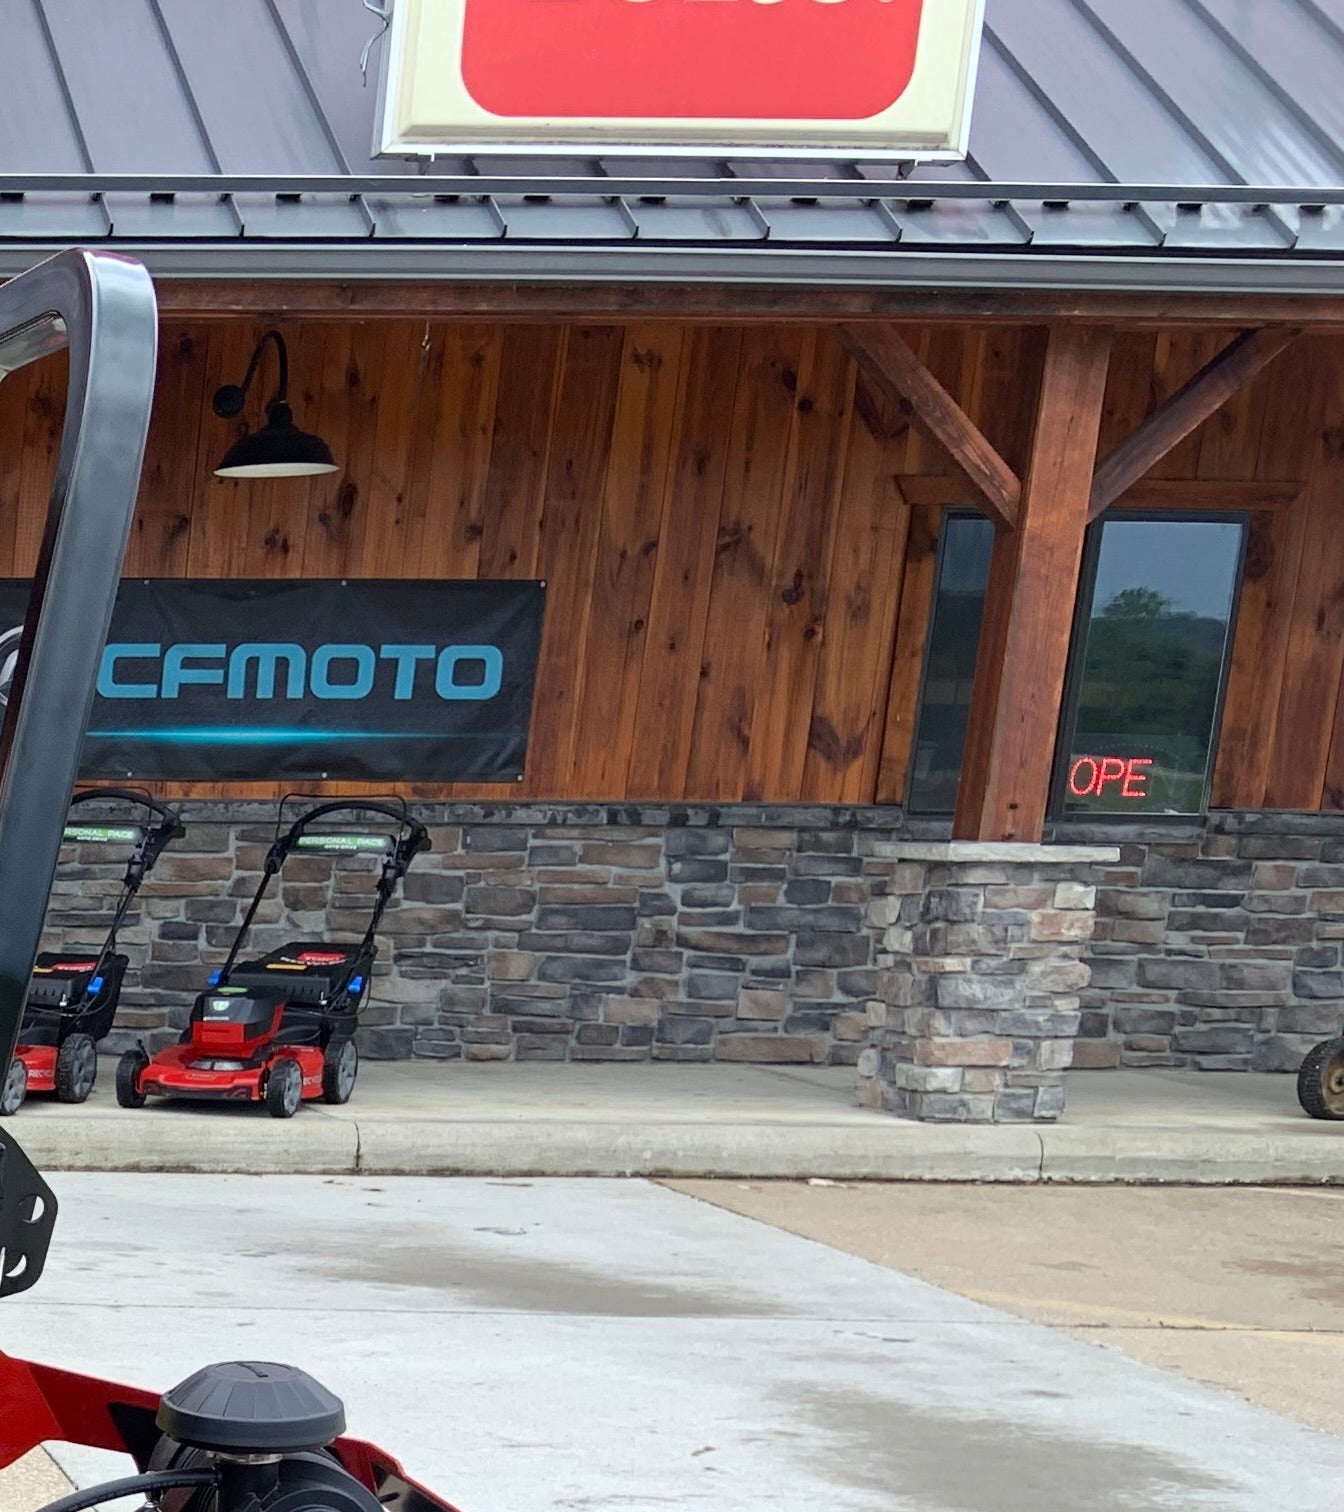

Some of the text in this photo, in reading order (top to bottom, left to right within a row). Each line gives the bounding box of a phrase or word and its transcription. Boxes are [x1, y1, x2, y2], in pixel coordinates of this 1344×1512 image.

[97, 643, 503, 700] CFMOTO
[64, 827, 134, 839] RSONAL PACE
[298, 836, 386, 847] PERSONAL PACE
